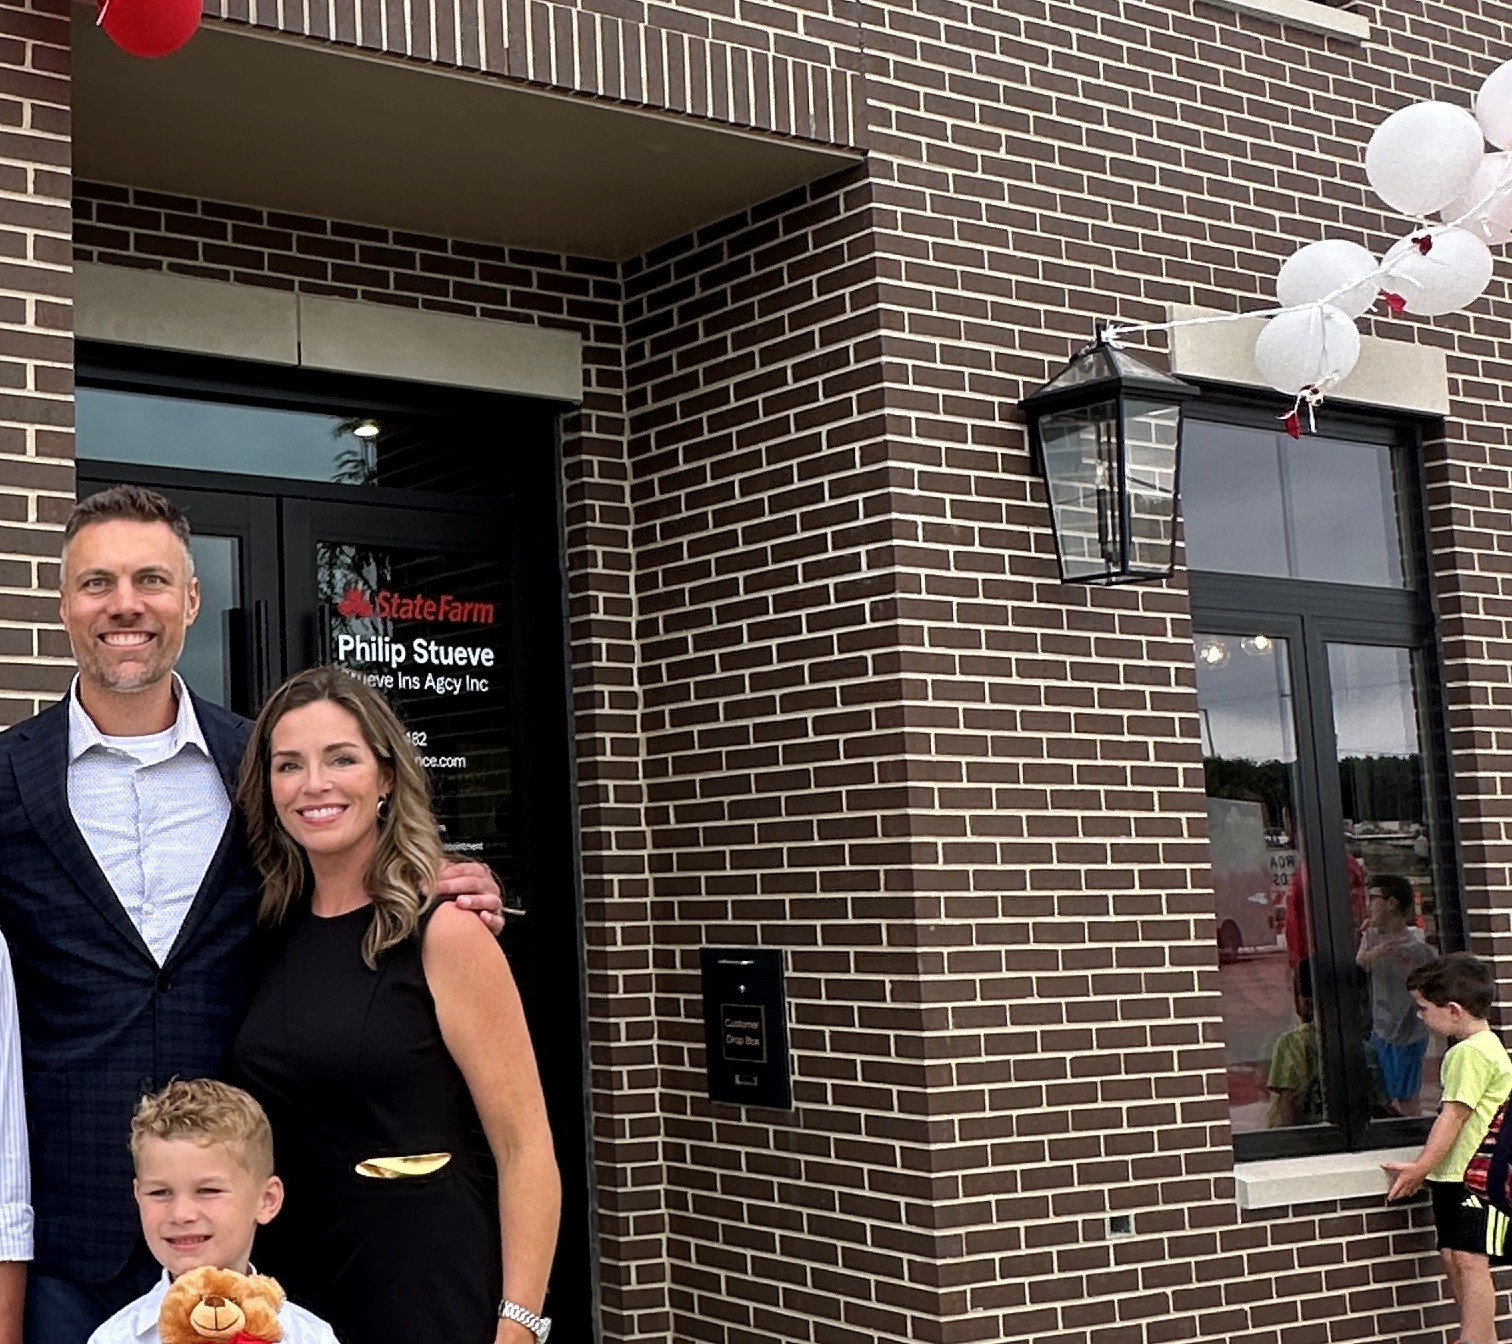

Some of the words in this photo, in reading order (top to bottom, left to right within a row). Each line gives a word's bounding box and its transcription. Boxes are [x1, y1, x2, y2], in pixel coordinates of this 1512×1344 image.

[338, 634, 406, 668] Philip
[413, 638, 494, 667] Stueve
[342, 667, 394, 688] ueve
[398, 671, 421, 690] Ins
[424, 672, 462, 695] Agcy
[466, 674, 489, 692] Inc
